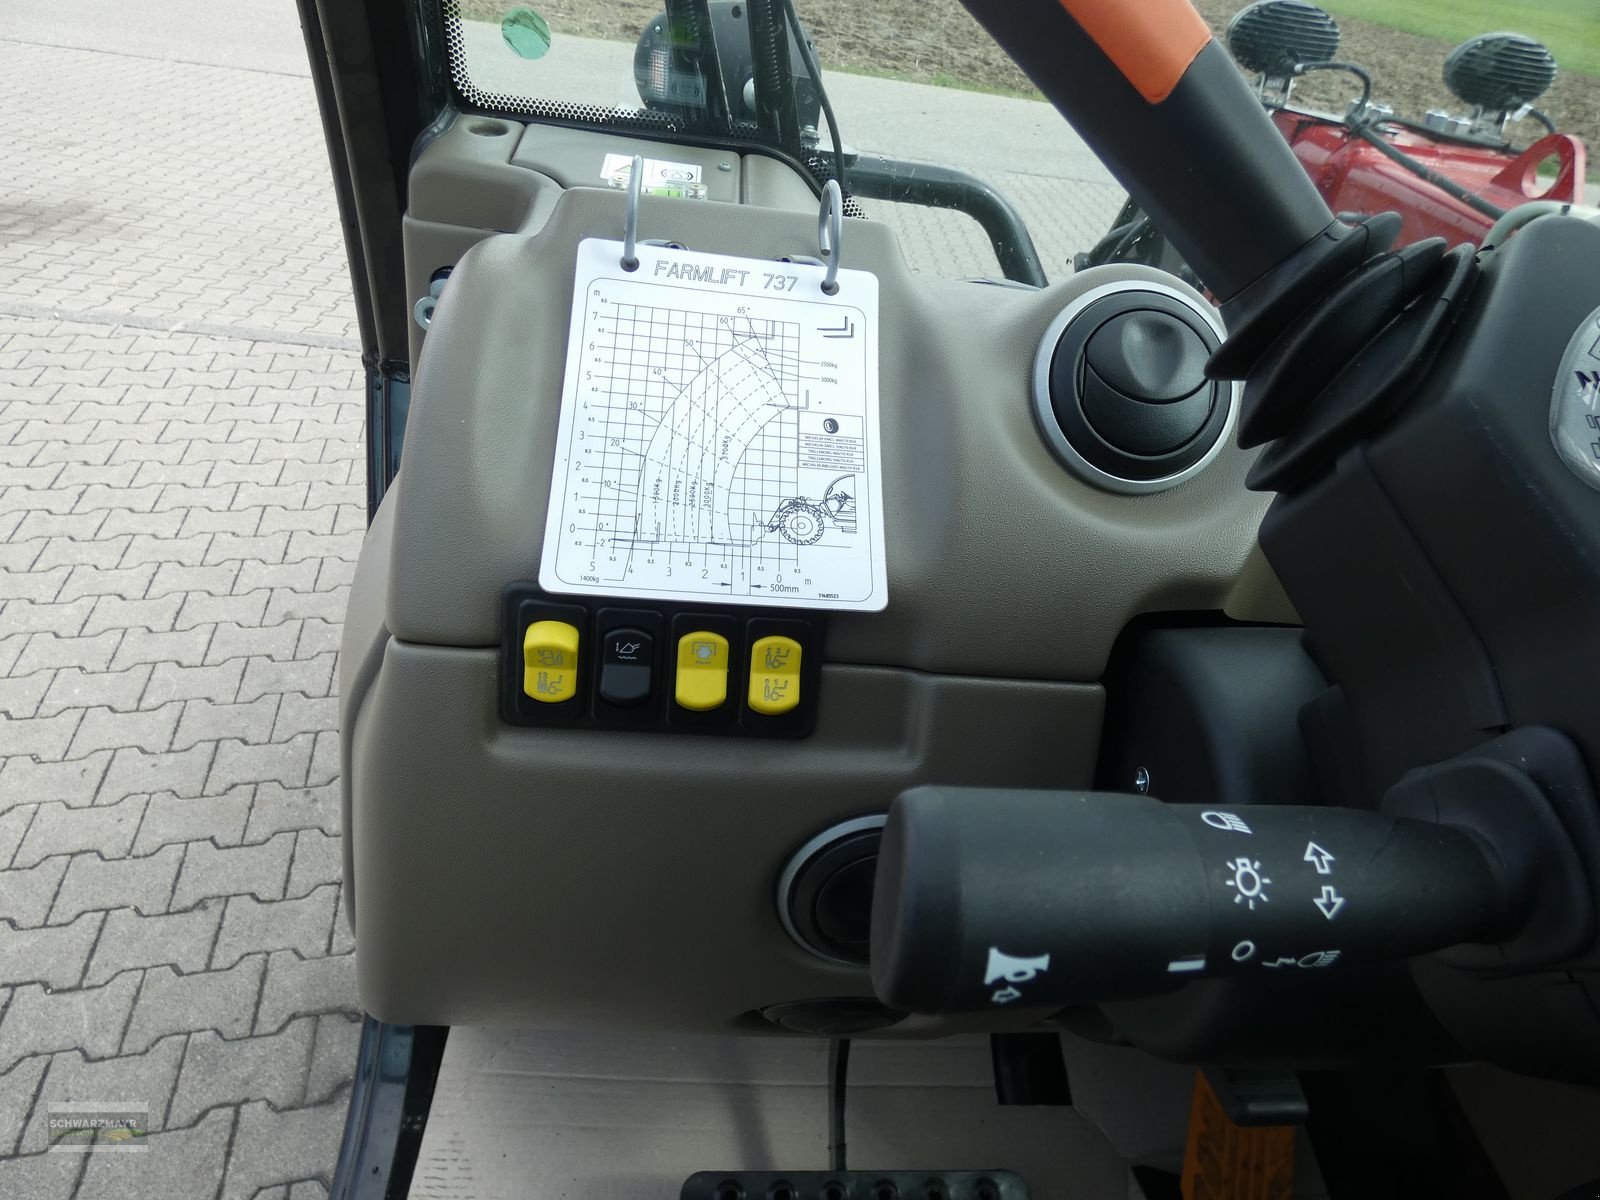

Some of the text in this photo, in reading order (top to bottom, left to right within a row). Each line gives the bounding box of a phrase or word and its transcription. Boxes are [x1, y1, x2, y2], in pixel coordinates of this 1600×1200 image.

[654, 260, 798, 291] FARMLIFT 737
[592, 311, 598, 320] 7
[589, 342, 595, 350] 6
[586, 371, 592, 380] 5
[583, 401, 588, 409] 4
[579, 431, 585, 440] 3
[575, 461, 581, 470] 2
[570, 523, 576, 533] 0
[590, 561, 596, 571] 5
[628, 564, 633, 574] 4
[666, 567, 672, 577] 3
[701, 569, 709, 579] 2
[776, 574, 782, 583] 0
[770, 583, 800, 593] 500mm
